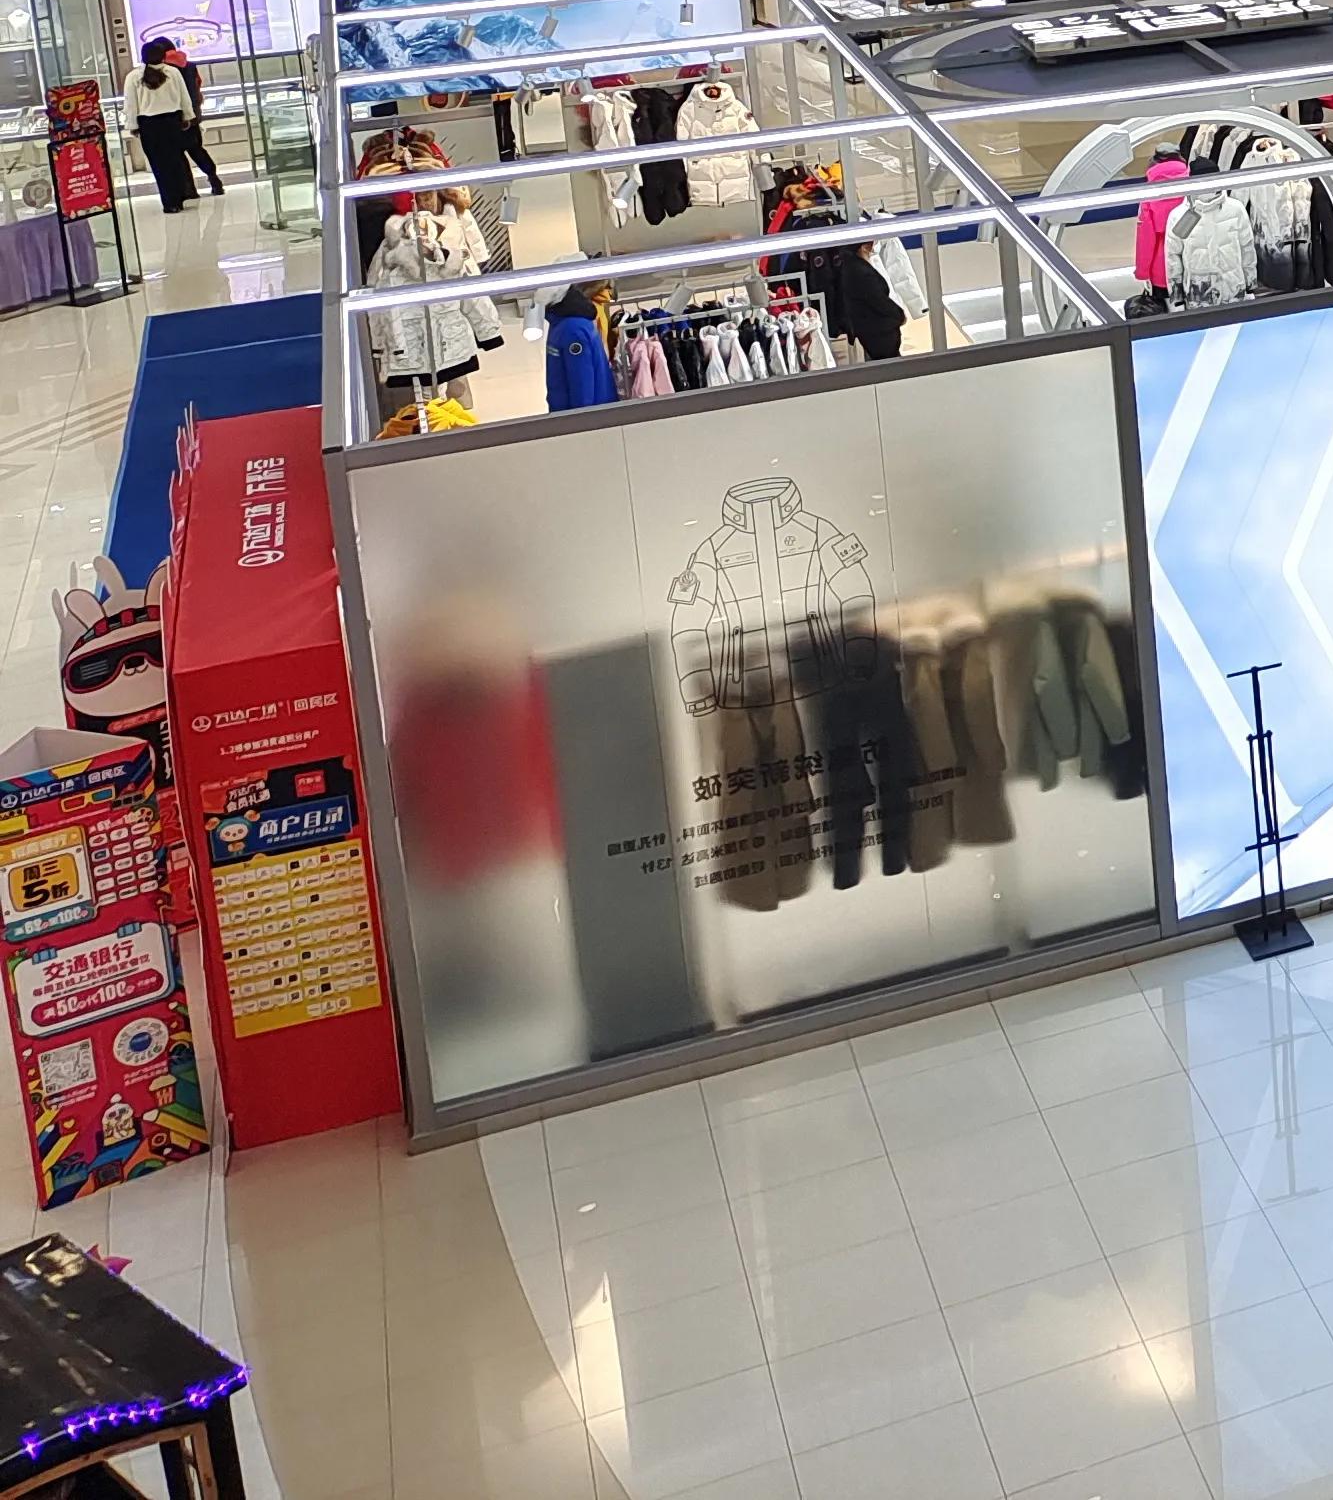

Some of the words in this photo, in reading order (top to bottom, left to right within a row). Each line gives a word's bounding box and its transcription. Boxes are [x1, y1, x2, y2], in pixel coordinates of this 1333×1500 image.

[259, 805, 344, 839] 商户目录
[22, 859, 61, 883] 周三
[22, 878, 70, 909] 5折
[42, 940, 134, 983] 交通银行
